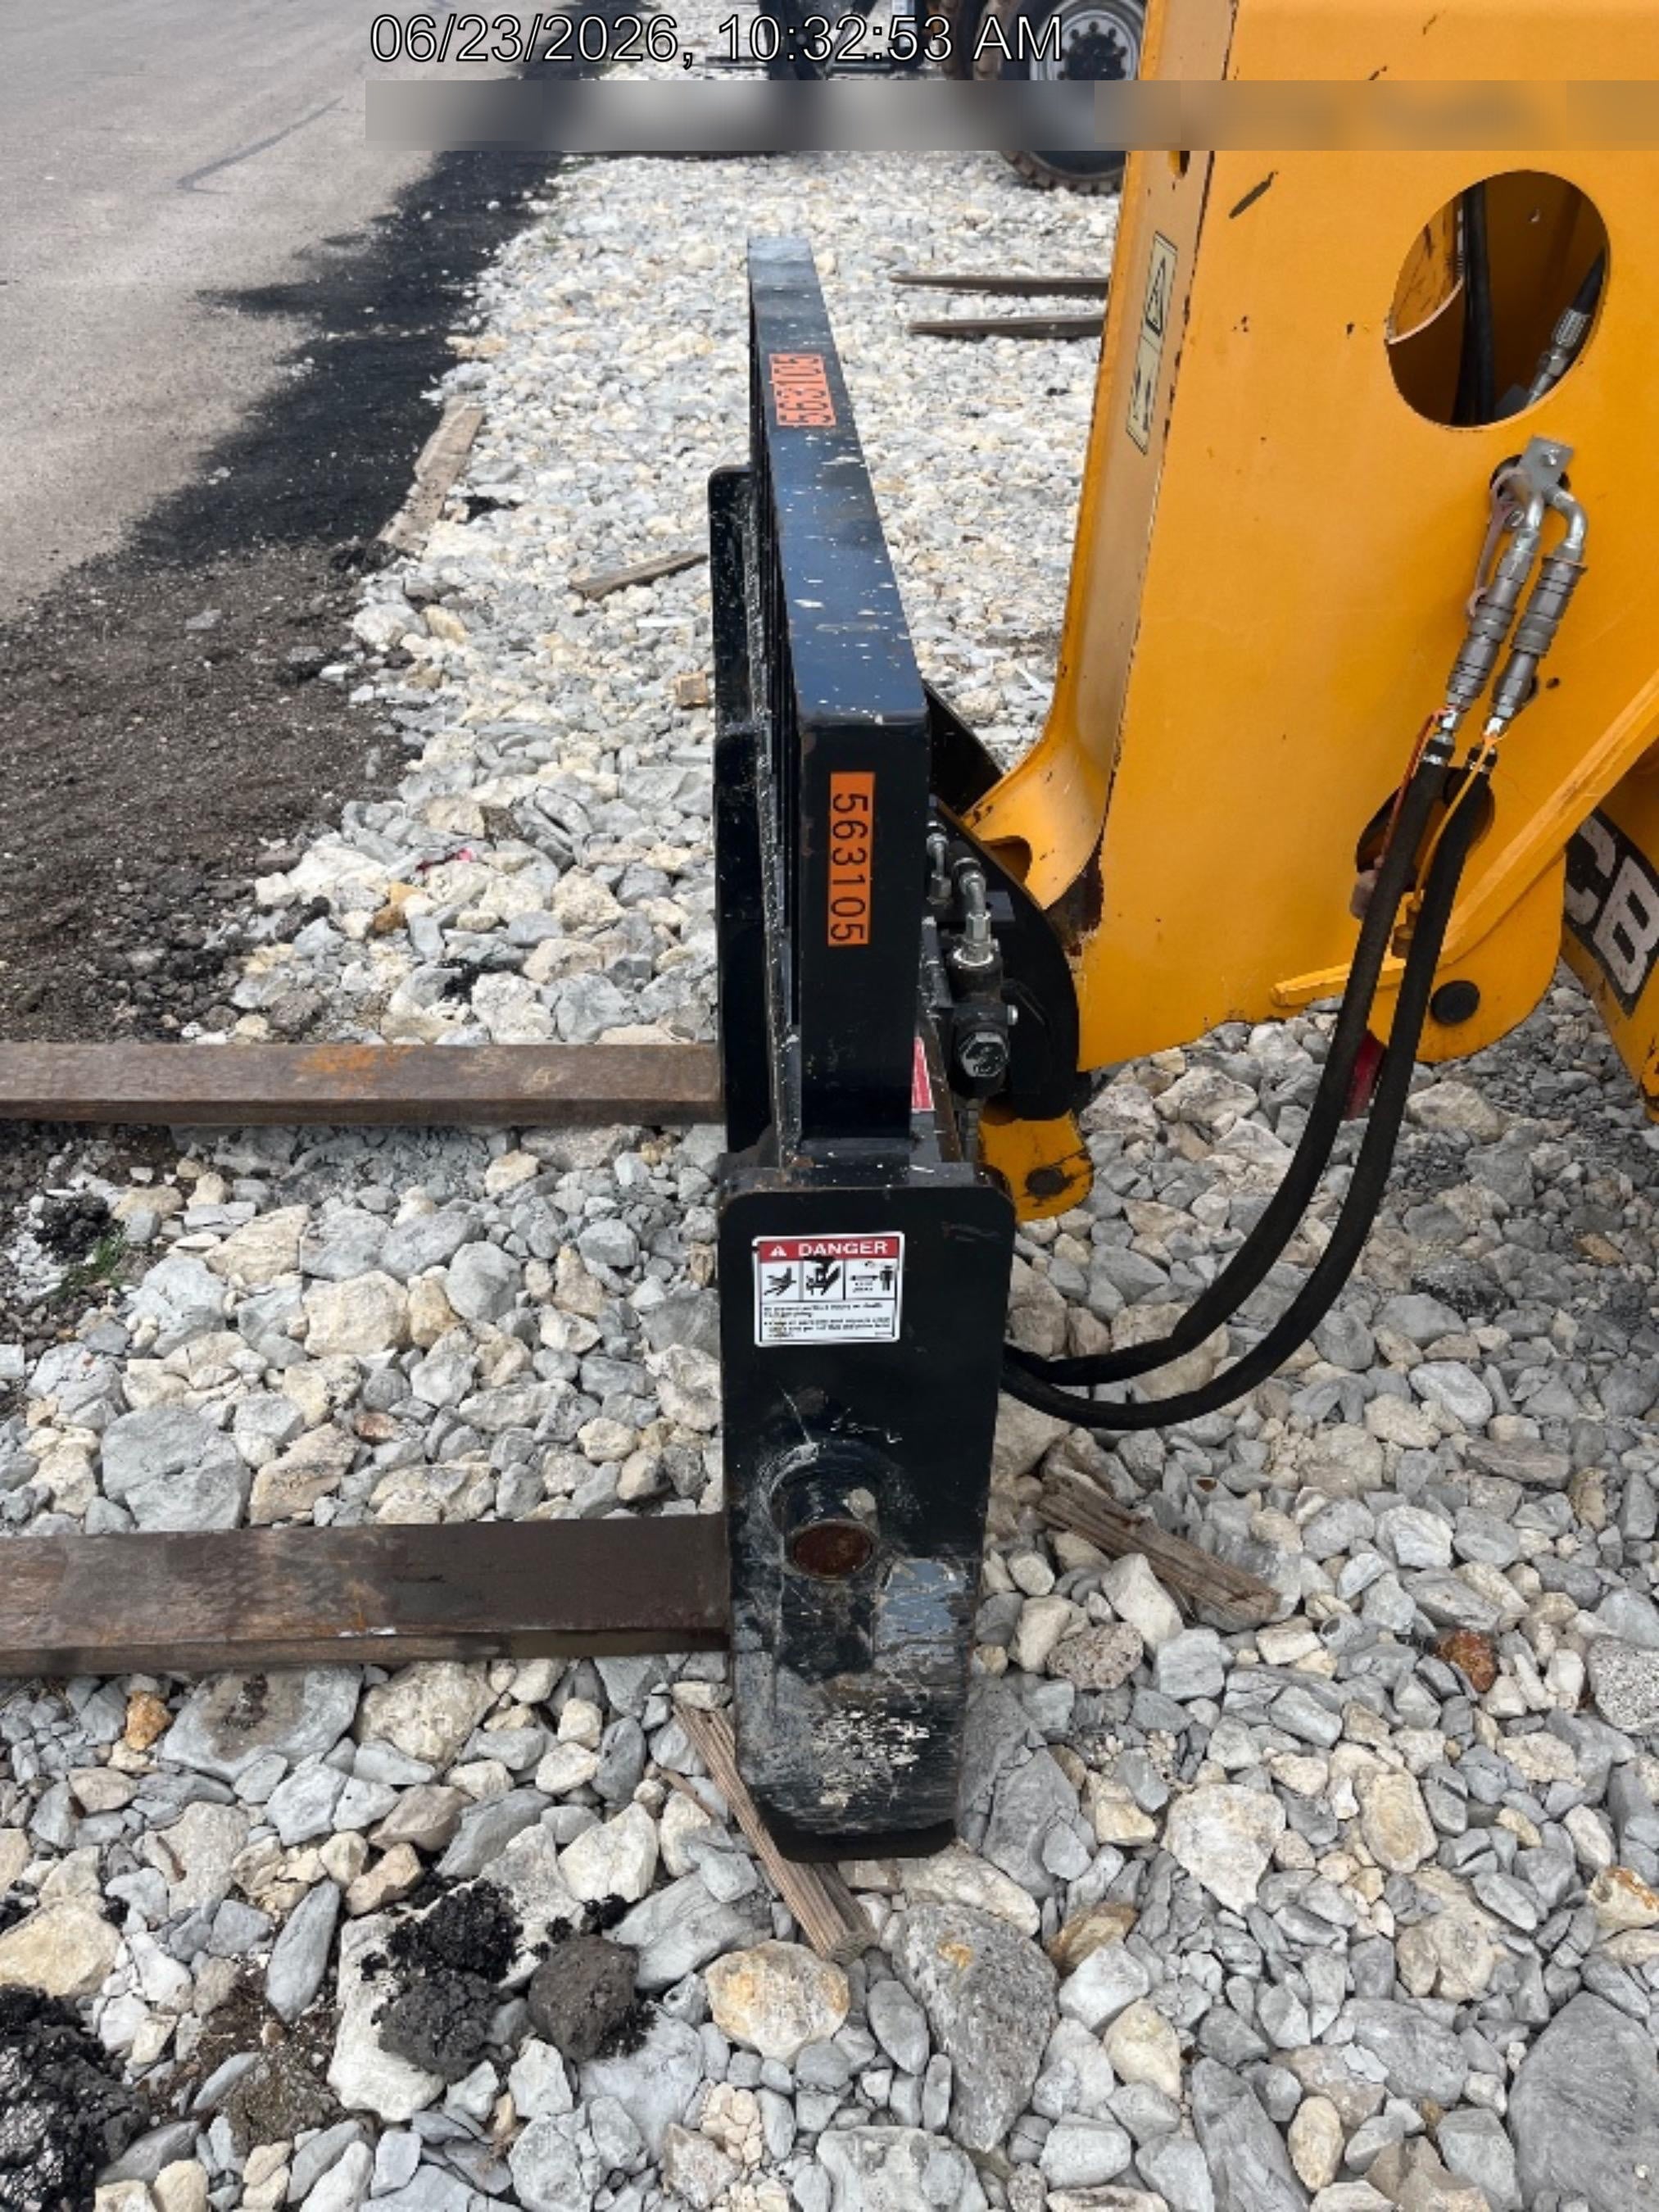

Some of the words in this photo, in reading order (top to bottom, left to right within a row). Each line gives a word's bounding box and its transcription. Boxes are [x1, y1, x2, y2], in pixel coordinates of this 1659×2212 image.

[772, 356, 832, 424] 563105
[831, 792, 869, 941] 563105
[798, 1240, 888, 1257] DANGER
